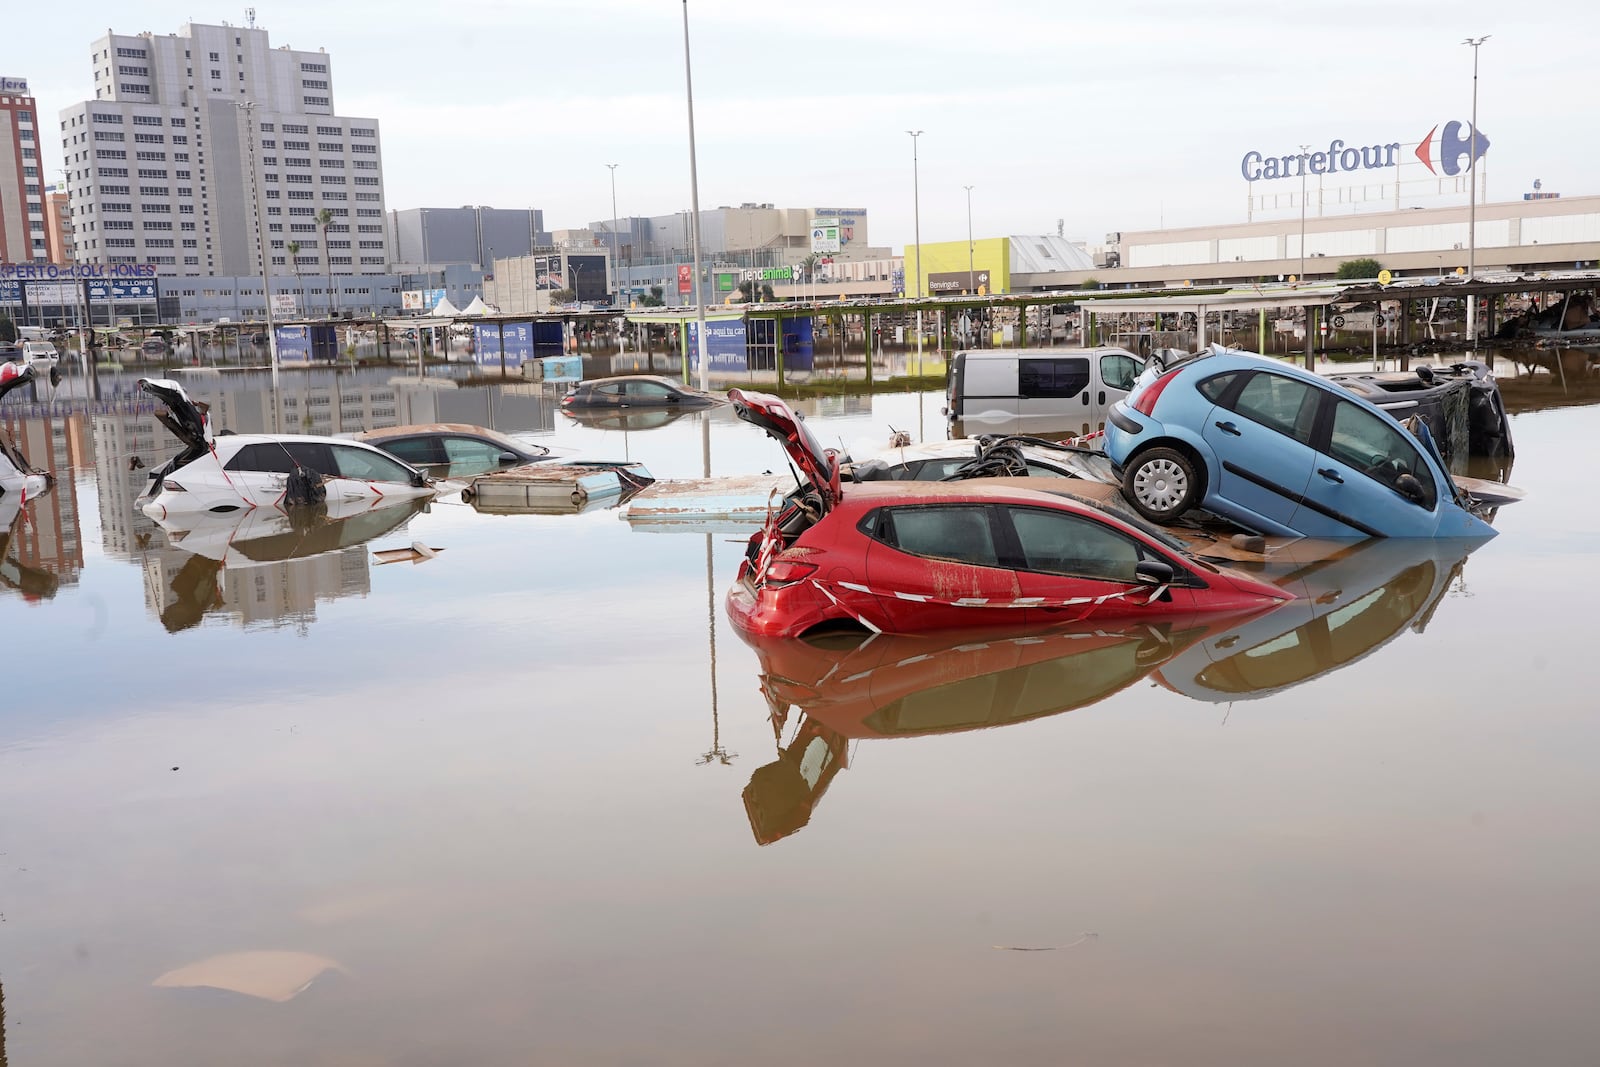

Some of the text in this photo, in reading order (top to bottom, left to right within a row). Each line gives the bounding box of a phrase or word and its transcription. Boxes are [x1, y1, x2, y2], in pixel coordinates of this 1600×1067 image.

[1241, 139, 1400, 181] Carrefour
[816, 207, 867, 216] Centro Comercial
[741, 266, 792, 281] Tiendanimal
[0, 281, 19, 289] NES
[929, 281, 959, 289] Benvinguts
